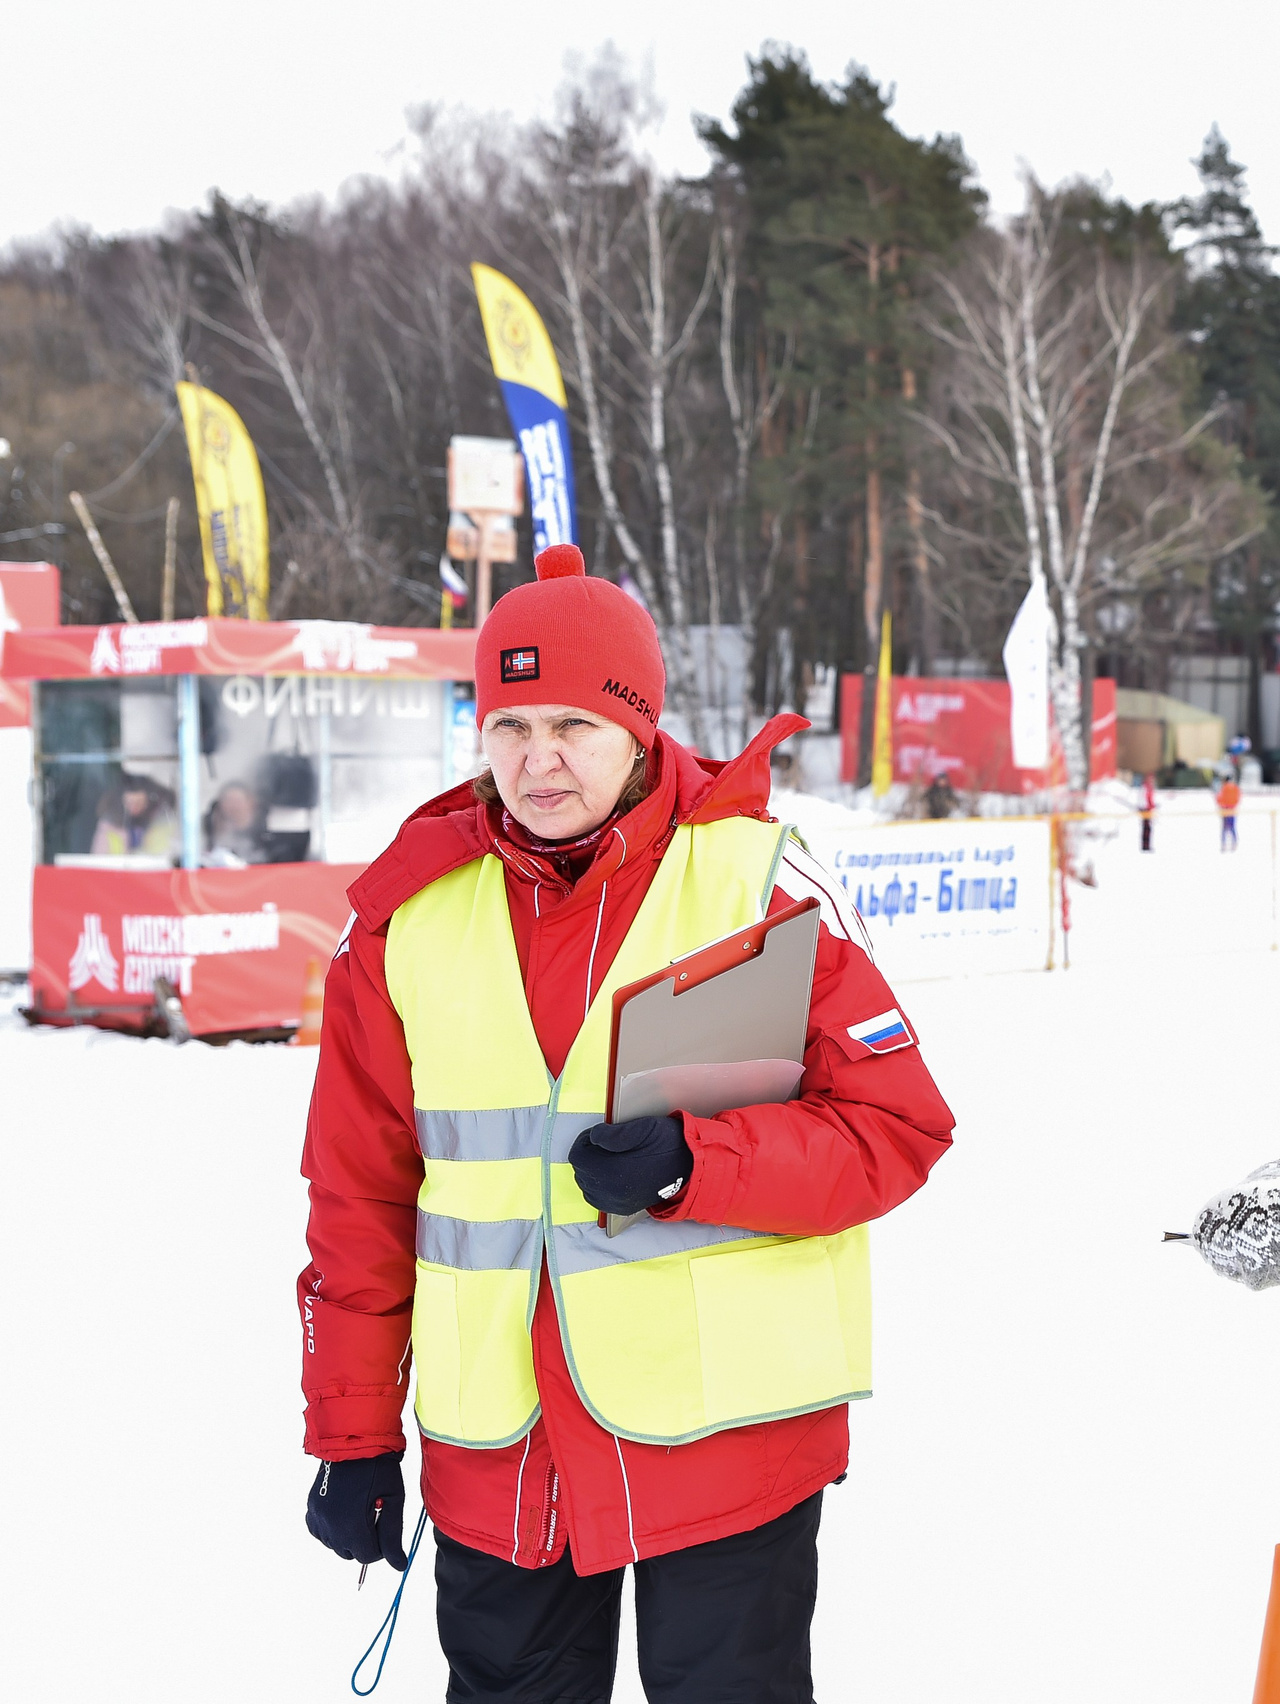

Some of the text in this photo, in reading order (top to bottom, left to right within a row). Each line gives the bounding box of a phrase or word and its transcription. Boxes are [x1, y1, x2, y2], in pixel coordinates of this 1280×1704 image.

[505, 670, 535, 678] MADSHUS
[222, 675, 430, 718] ФИНИШ
[841, 868, 1018, 927] льфа-Битца
[551, 1472, 559, 1502] WARD
[546, 1508, 557, 1551] FORWARD
